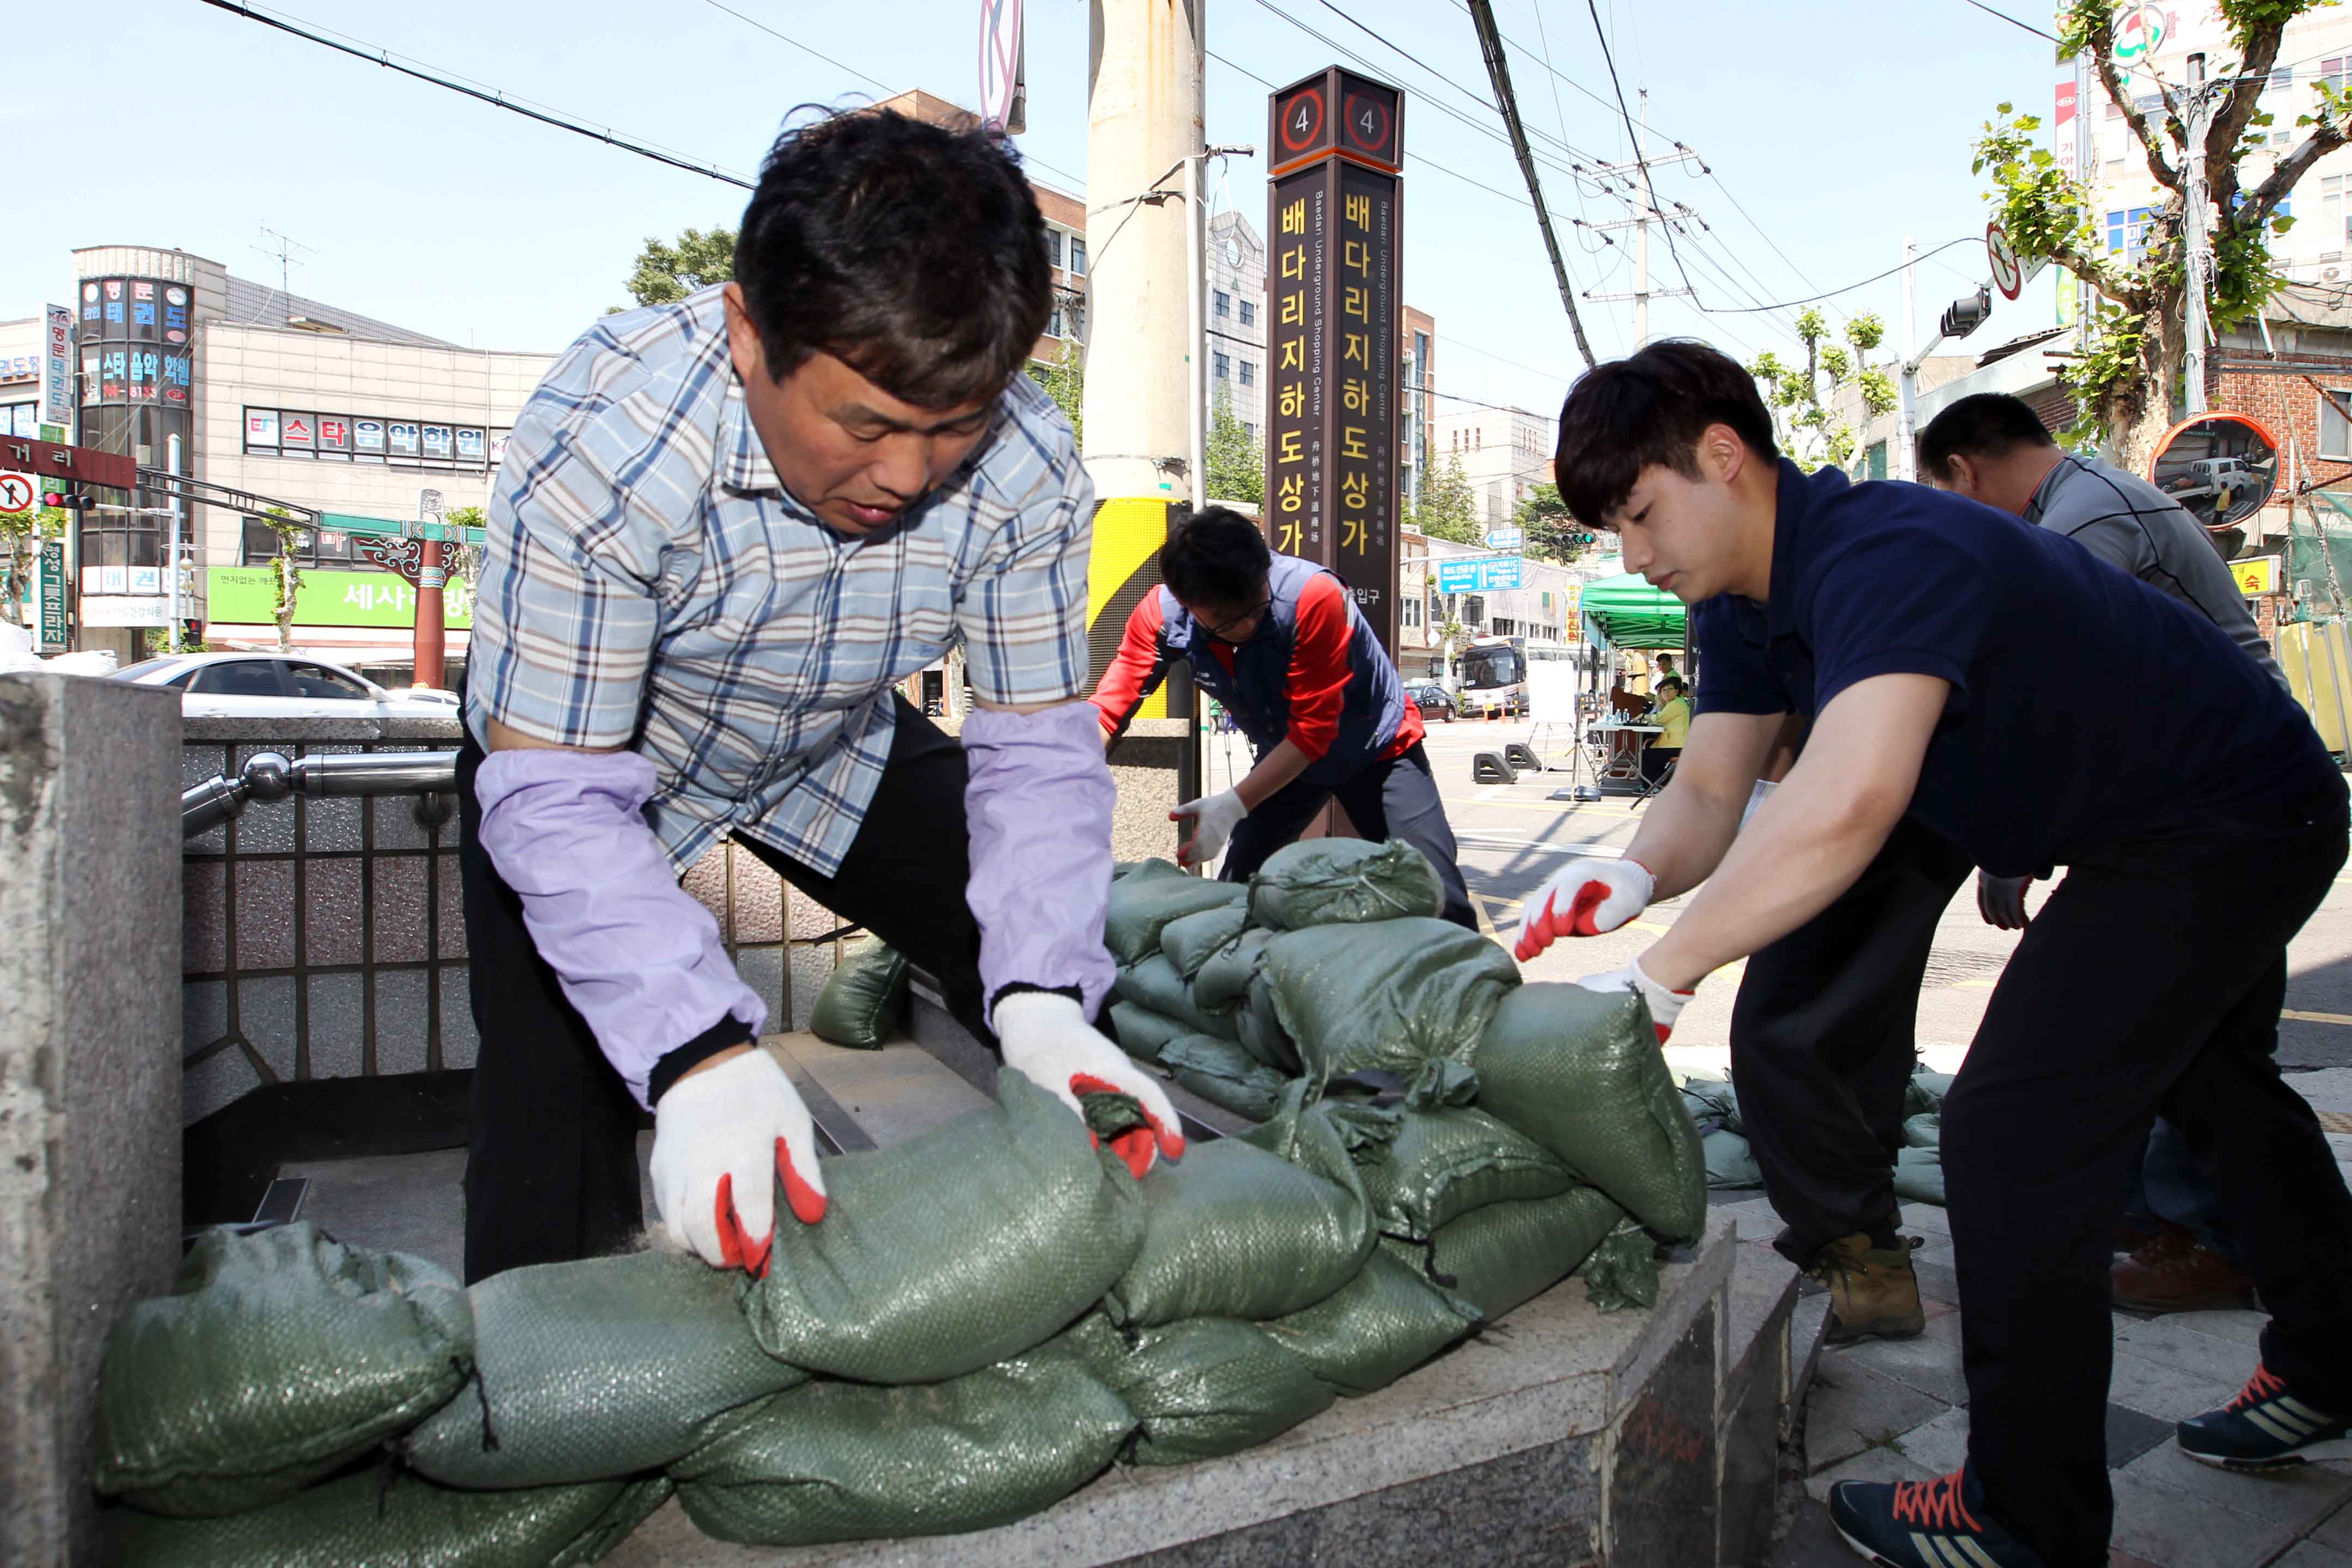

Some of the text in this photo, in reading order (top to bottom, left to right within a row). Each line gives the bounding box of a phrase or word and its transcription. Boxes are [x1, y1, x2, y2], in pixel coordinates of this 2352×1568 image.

[1295, 106, 1309, 132] 4
[1360, 109, 1374, 134] 4
[1313, 240, 1323, 315] Underground
[1379, 249, 1388, 323] Underground
[48, 310, 69, 323] KTA
[106, 302, 187, 329] 태권도
[52, 327, 65, 406] 명문태권도
[1313, 319, 1322, 373] Shopping
[1377, 327, 1387, 379] Shopping
[1278, 197, 1307, 556] 배다리지하도상가
[1313, 378, 1322, 416] Center
[1342, 193, 1372, 556] 배다리지하도상가
